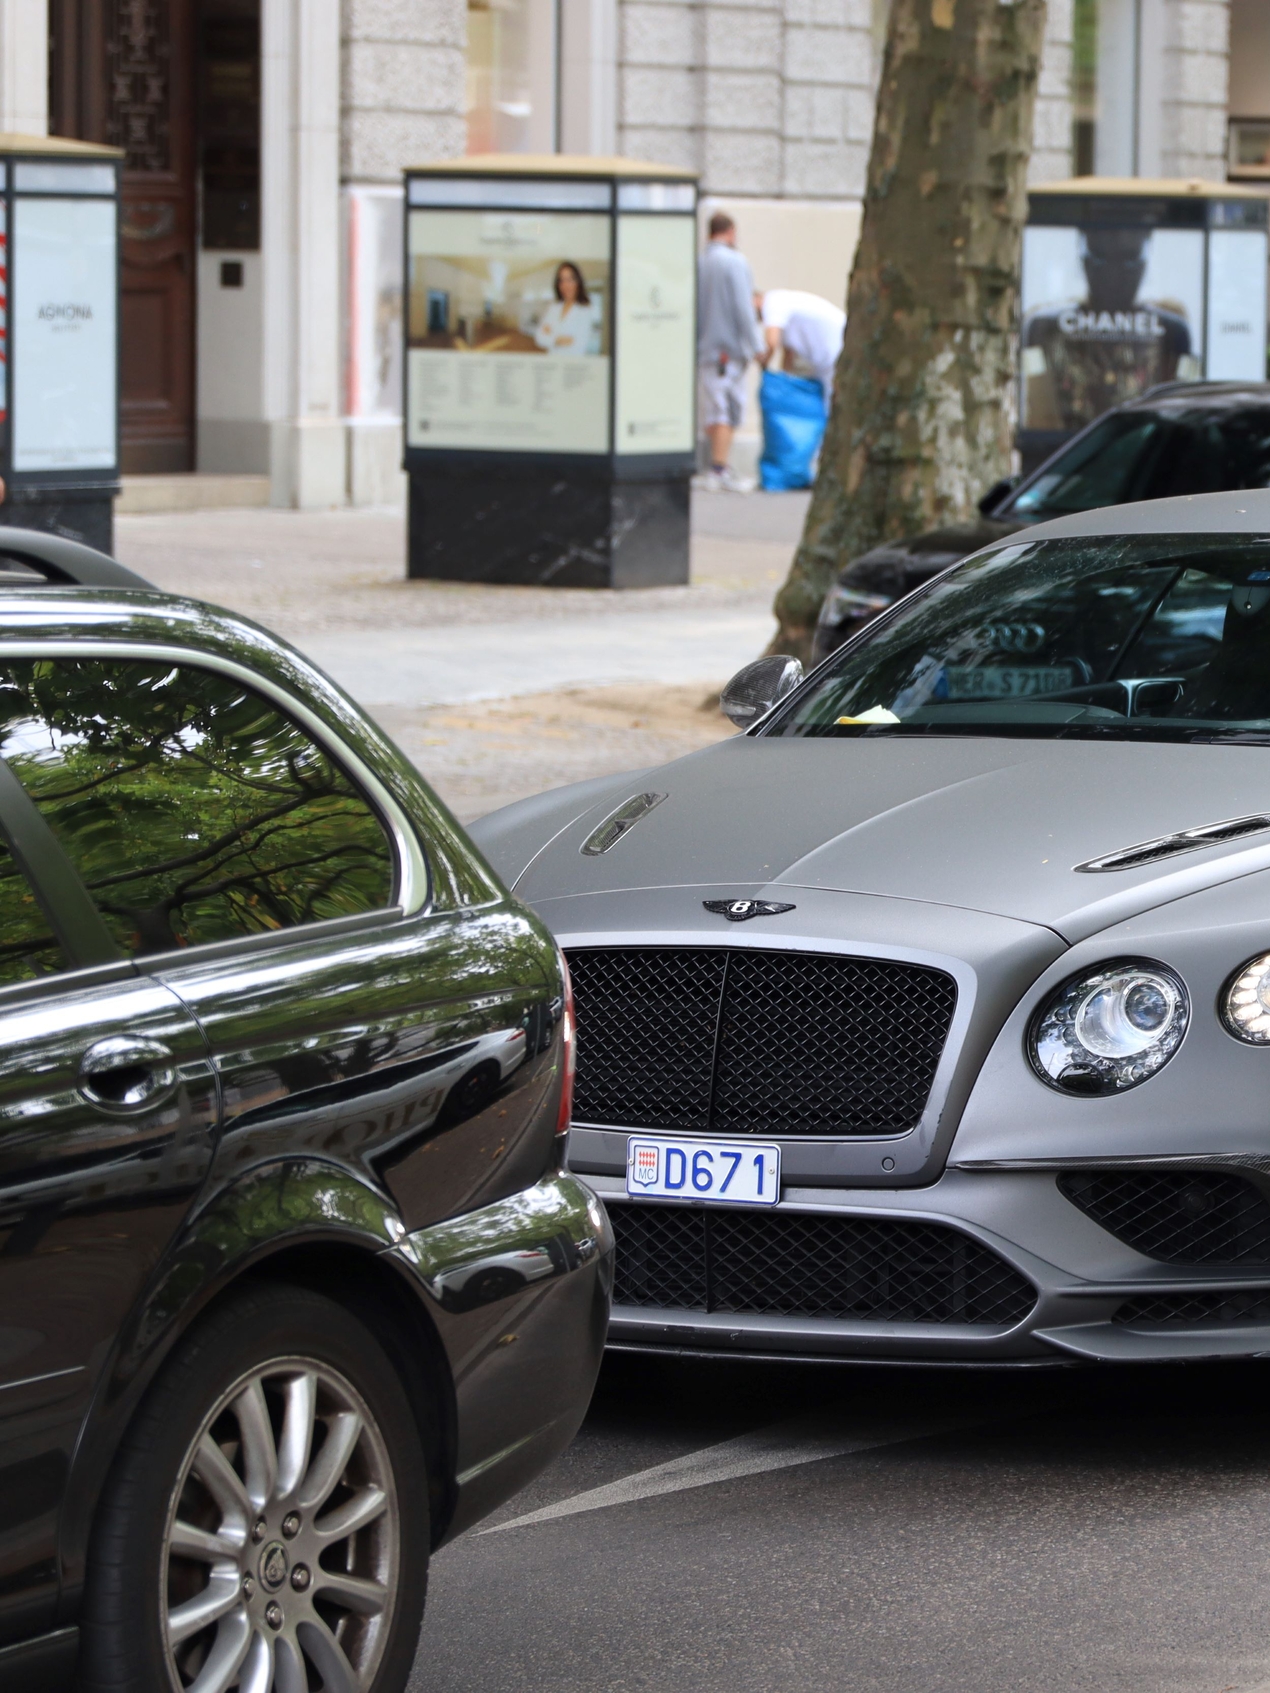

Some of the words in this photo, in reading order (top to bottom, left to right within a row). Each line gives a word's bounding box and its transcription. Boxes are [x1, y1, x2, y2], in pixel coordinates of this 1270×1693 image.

[1057, 308, 1167, 337] CHANEL
[638, 1167, 655, 1181] MC
[664, 1147, 765, 1196] D671
